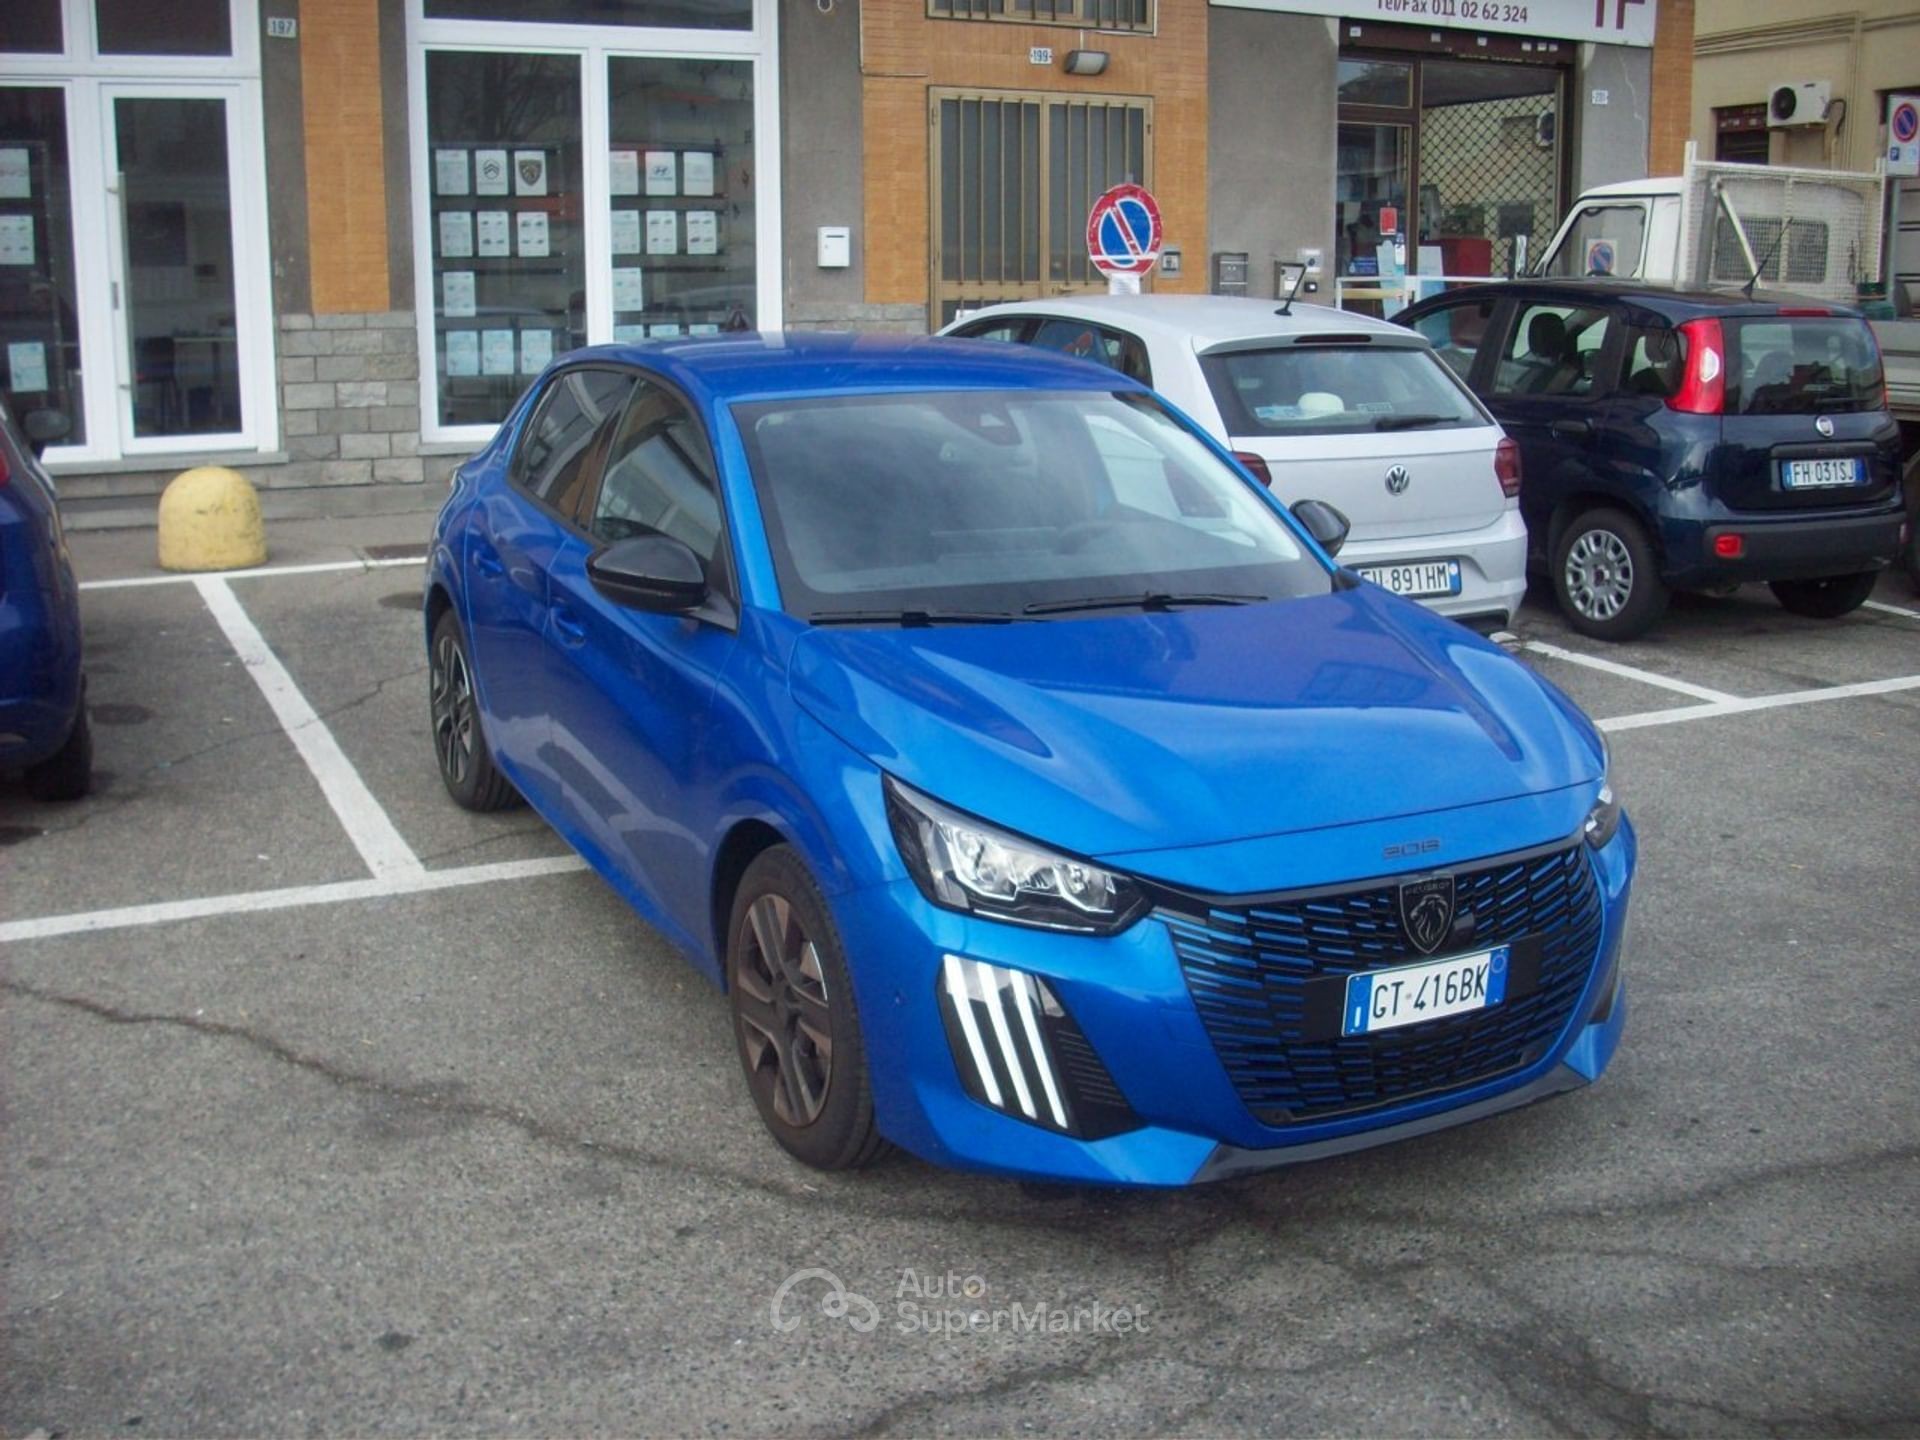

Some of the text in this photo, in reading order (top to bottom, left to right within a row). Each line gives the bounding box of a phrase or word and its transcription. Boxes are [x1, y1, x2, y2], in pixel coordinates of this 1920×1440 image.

[1432, 0, 1456, 16] 011
[1461, 0, 1478, 18] 02
[1482, 2, 1499, 20] 62
[1502, 4, 1528, 23] 324
[271, 20, 293, 34] 197
[1033, 49, 1048, 62] 199
[1793, 463, 1811, 482] FH
[1815, 461, 1855, 482] 031SJ
[1391, 564, 1449, 592] 891HM
[1373, 981, 1404, 1019] GT
[1414, 962, 1489, 1011] 416BK
